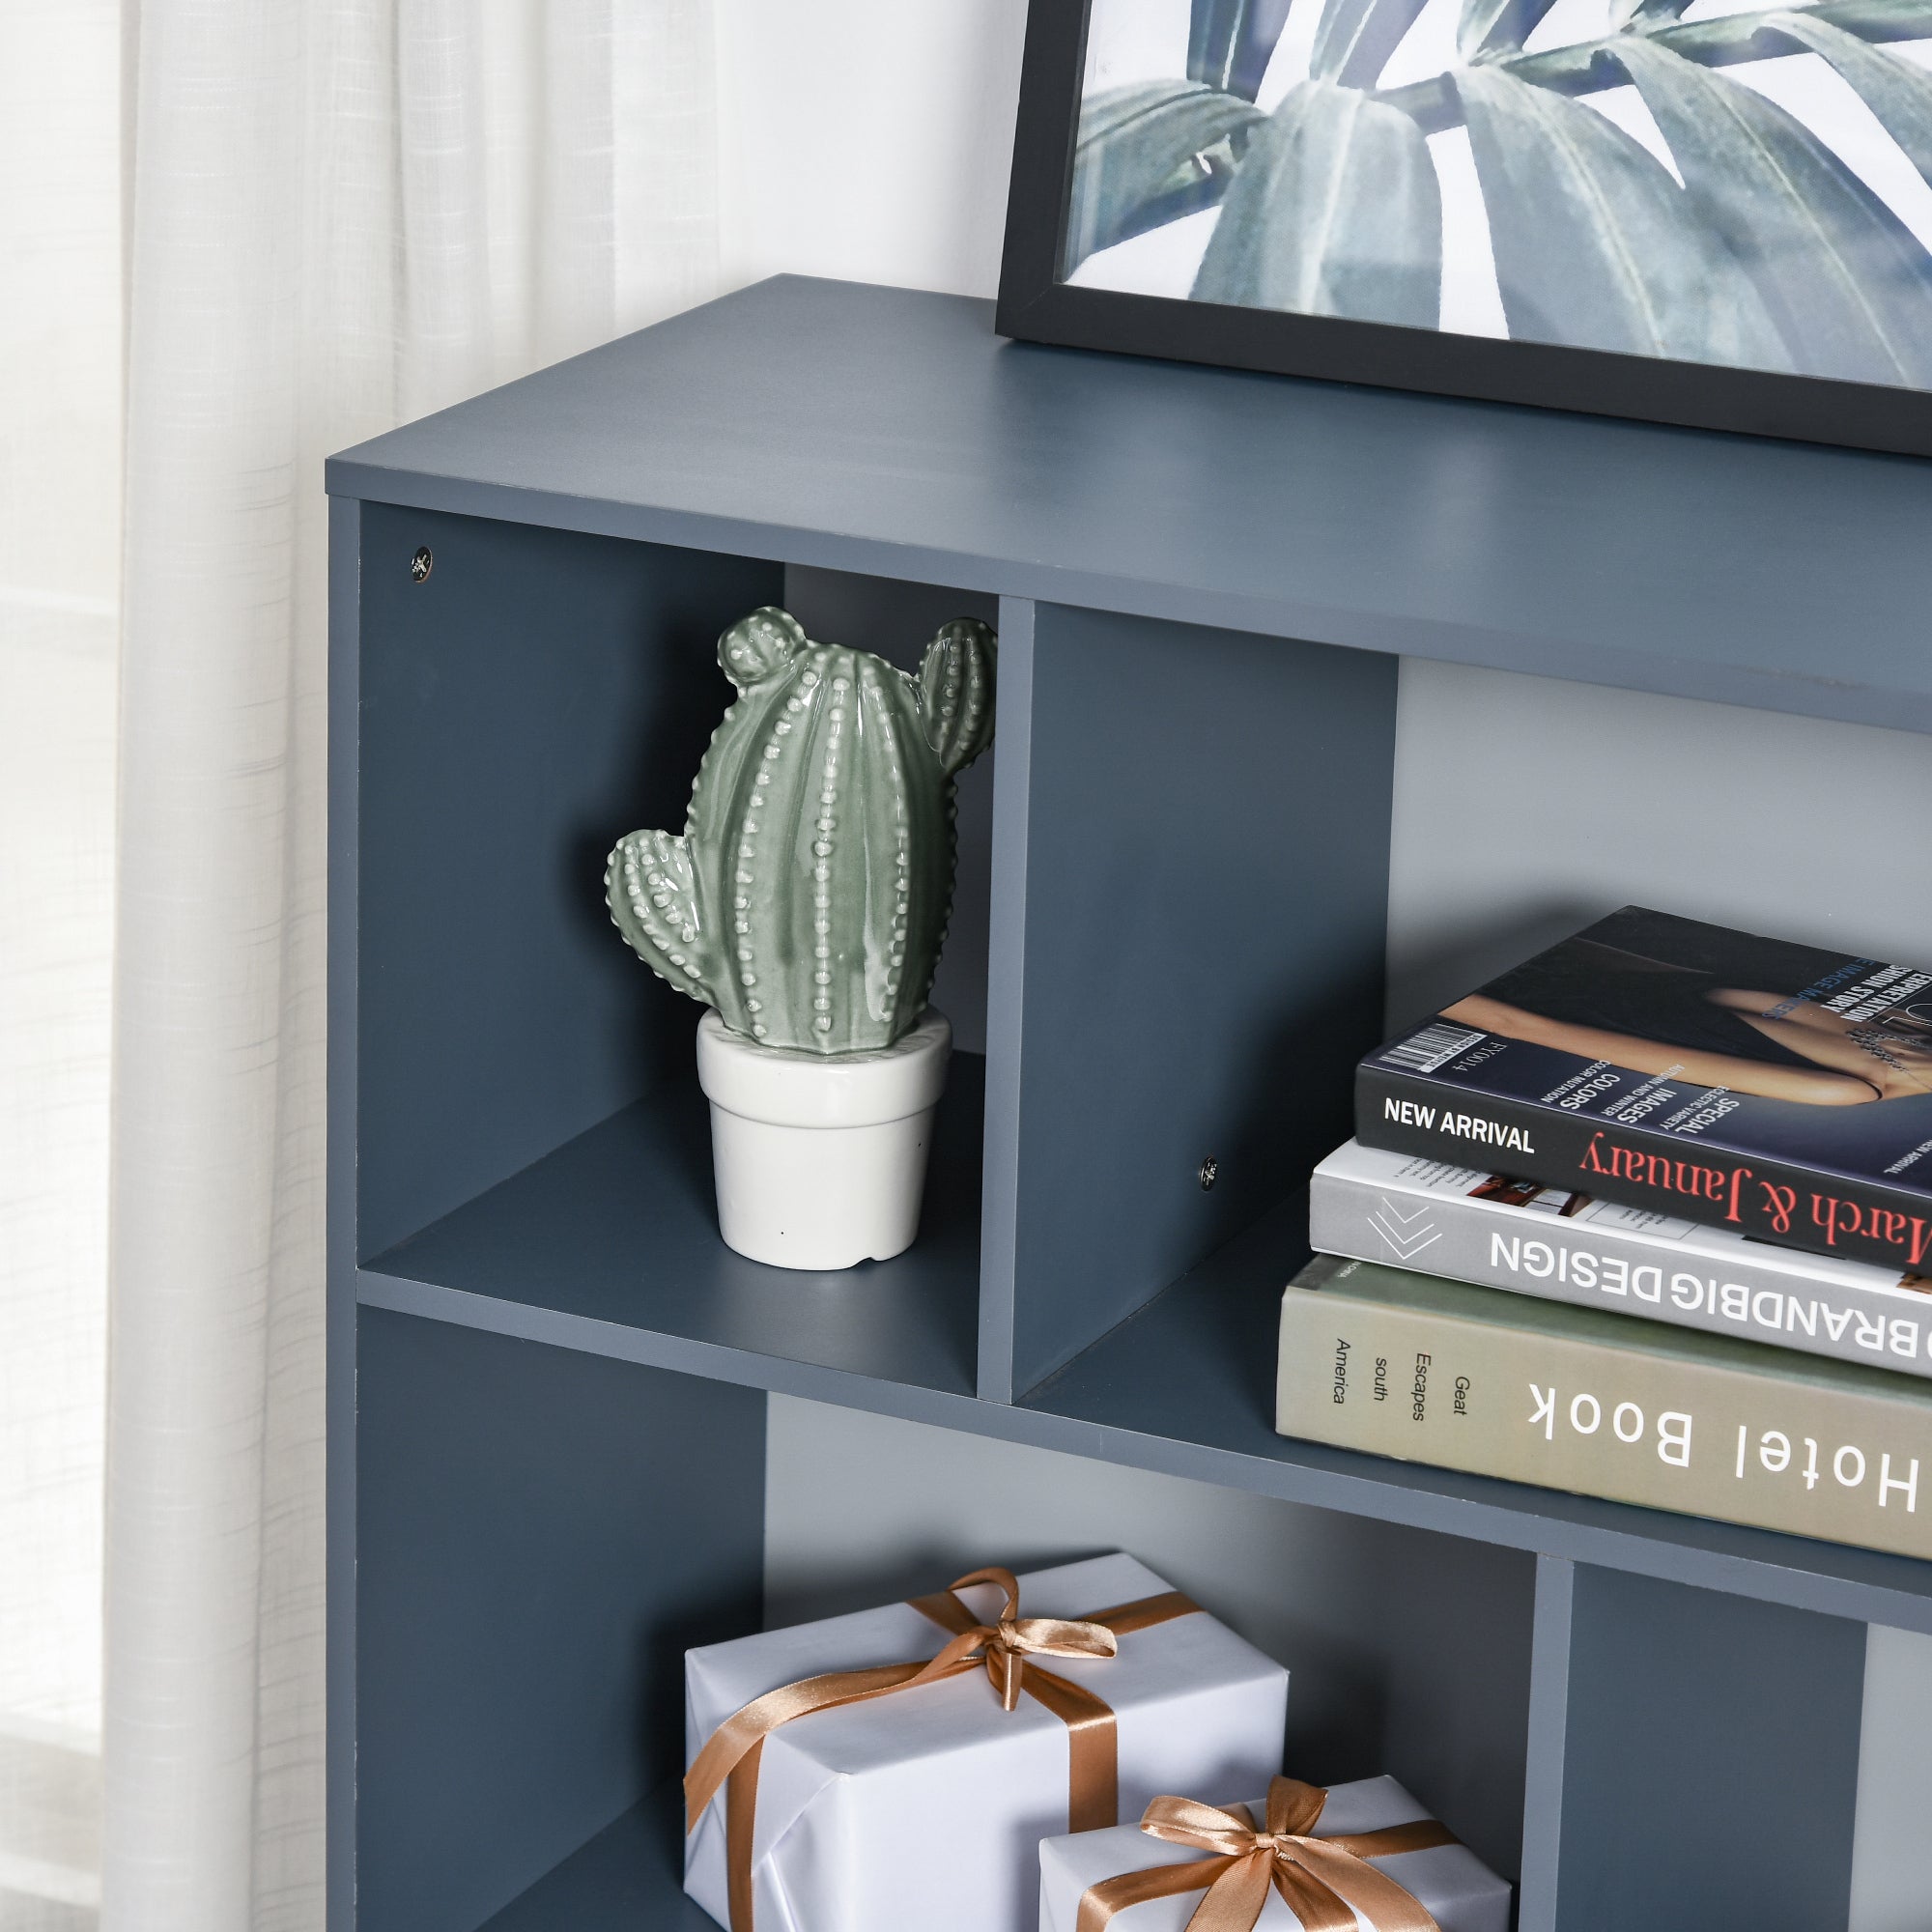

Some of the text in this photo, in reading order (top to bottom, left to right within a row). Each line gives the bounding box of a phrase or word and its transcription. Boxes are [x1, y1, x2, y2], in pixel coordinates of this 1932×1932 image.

[1814, 966, 1865, 990] IMAGE
[1820, 985, 1875, 1013] STORY
[1762, 987, 1824, 1020] MAKERS
[1451, 1041, 1508, 1072] FY0014
[1540, 1060, 1612, 1104] COLOR MUTATION
[1559, 1073, 1621, 1111] COLORS
[1601, 1064, 1686, 1118] AUTUMN AND WINTER
[1383, 1097, 1536, 1155] NEW ARRIVAL
[1617, 1088, 1678, 1124] IMAGES
[1660, 1085, 1731, 1131] ECLECTIC VARIETY
[1675, 1097, 1741, 1135] SPECIAL
[1579, 1131, 1753, 1223] January
[1883, 1151, 1922, 1174] ARRIVAL
[1758, 1180, 1798, 1234] &
[1491, 1233, 1662, 1303] DESIGN
[1333, 1338, 1351, 1405] America
[1374, 1357, 1388, 1402] south
[1410, 1352, 1432, 1422] Escapes
[1453, 1377, 1470, 1415] Geat
[1527, 1383, 1919, 1513] Hotel Book
